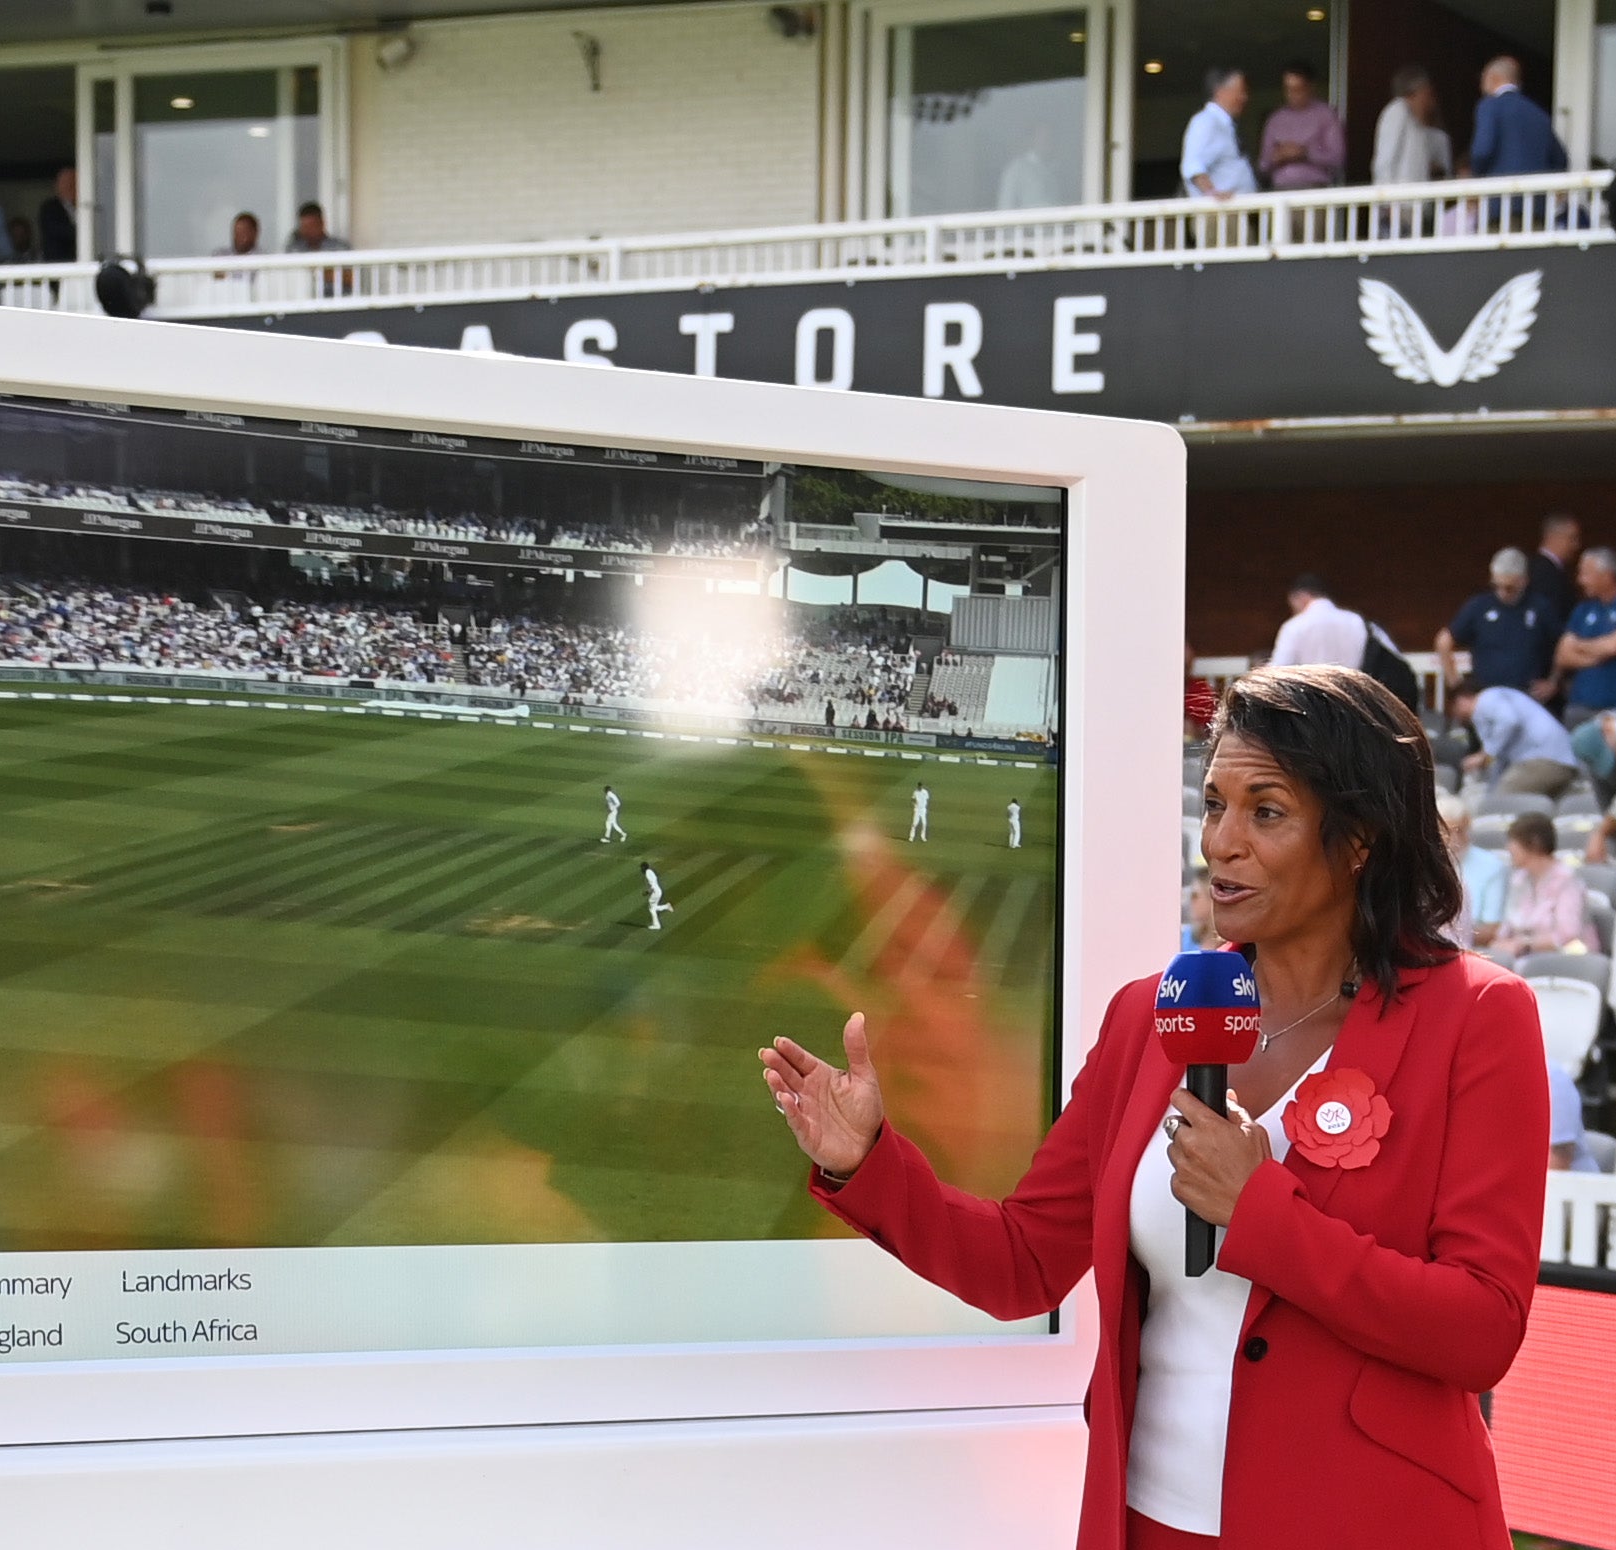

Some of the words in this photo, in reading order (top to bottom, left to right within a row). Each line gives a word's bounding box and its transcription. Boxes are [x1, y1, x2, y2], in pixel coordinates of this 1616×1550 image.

[344, 294, 1108, 399] STORE
[884, 731, 904, 744] IPA
[1159, 974, 1187, 1003] sky
[1232, 972, 1256, 1002] sky
[1224, 1013, 1261, 1036] sport
[122, 1268, 252, 1293] Landmarks
[115, 1320, 187, 1345] South
[191, 1318, 258, 1342] Africa
